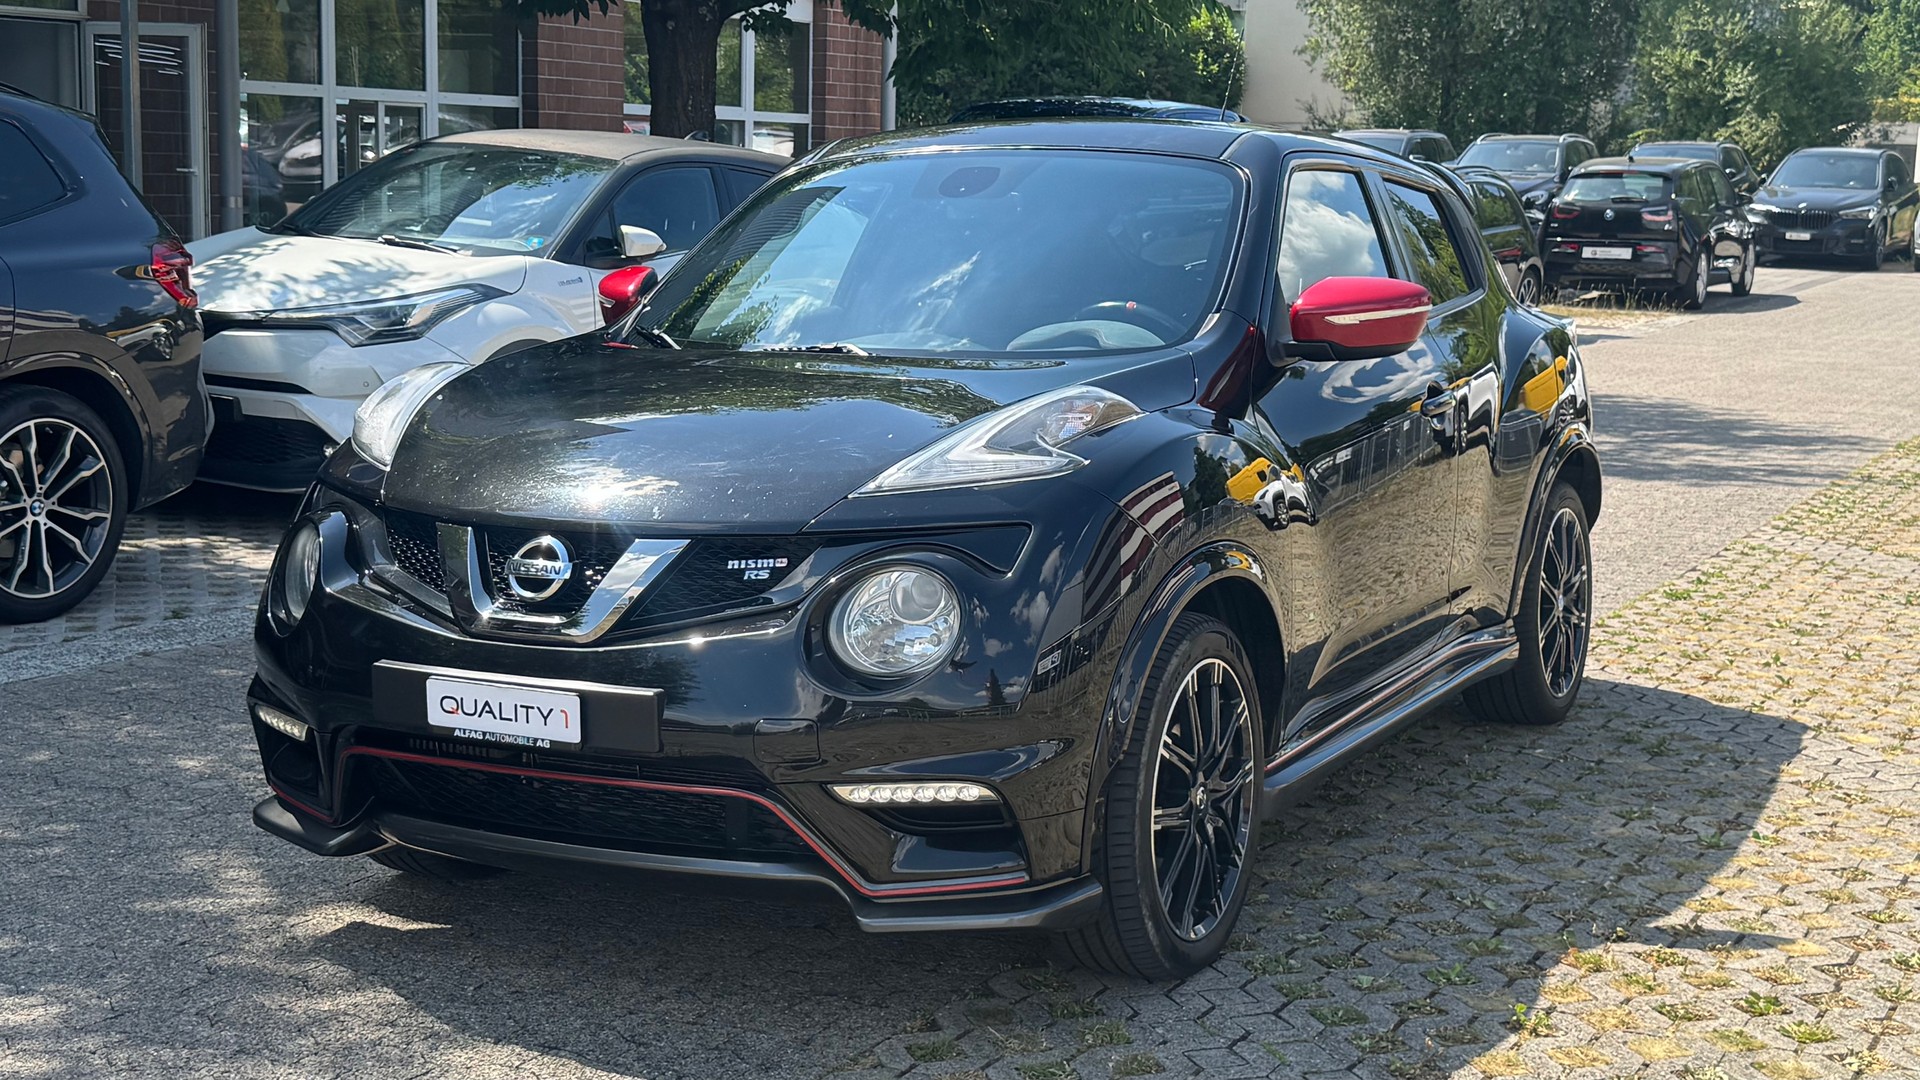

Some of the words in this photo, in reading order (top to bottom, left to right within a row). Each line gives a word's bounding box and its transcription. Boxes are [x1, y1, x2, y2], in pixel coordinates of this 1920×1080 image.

[509, 561, 562, 576] NISSAN
[743, 569, 770, 580] RS
[439, 695, 554, 726] QUALITY
[453, 728, 484, 740] ALFAG
[536, 738, 551, 749] AG
